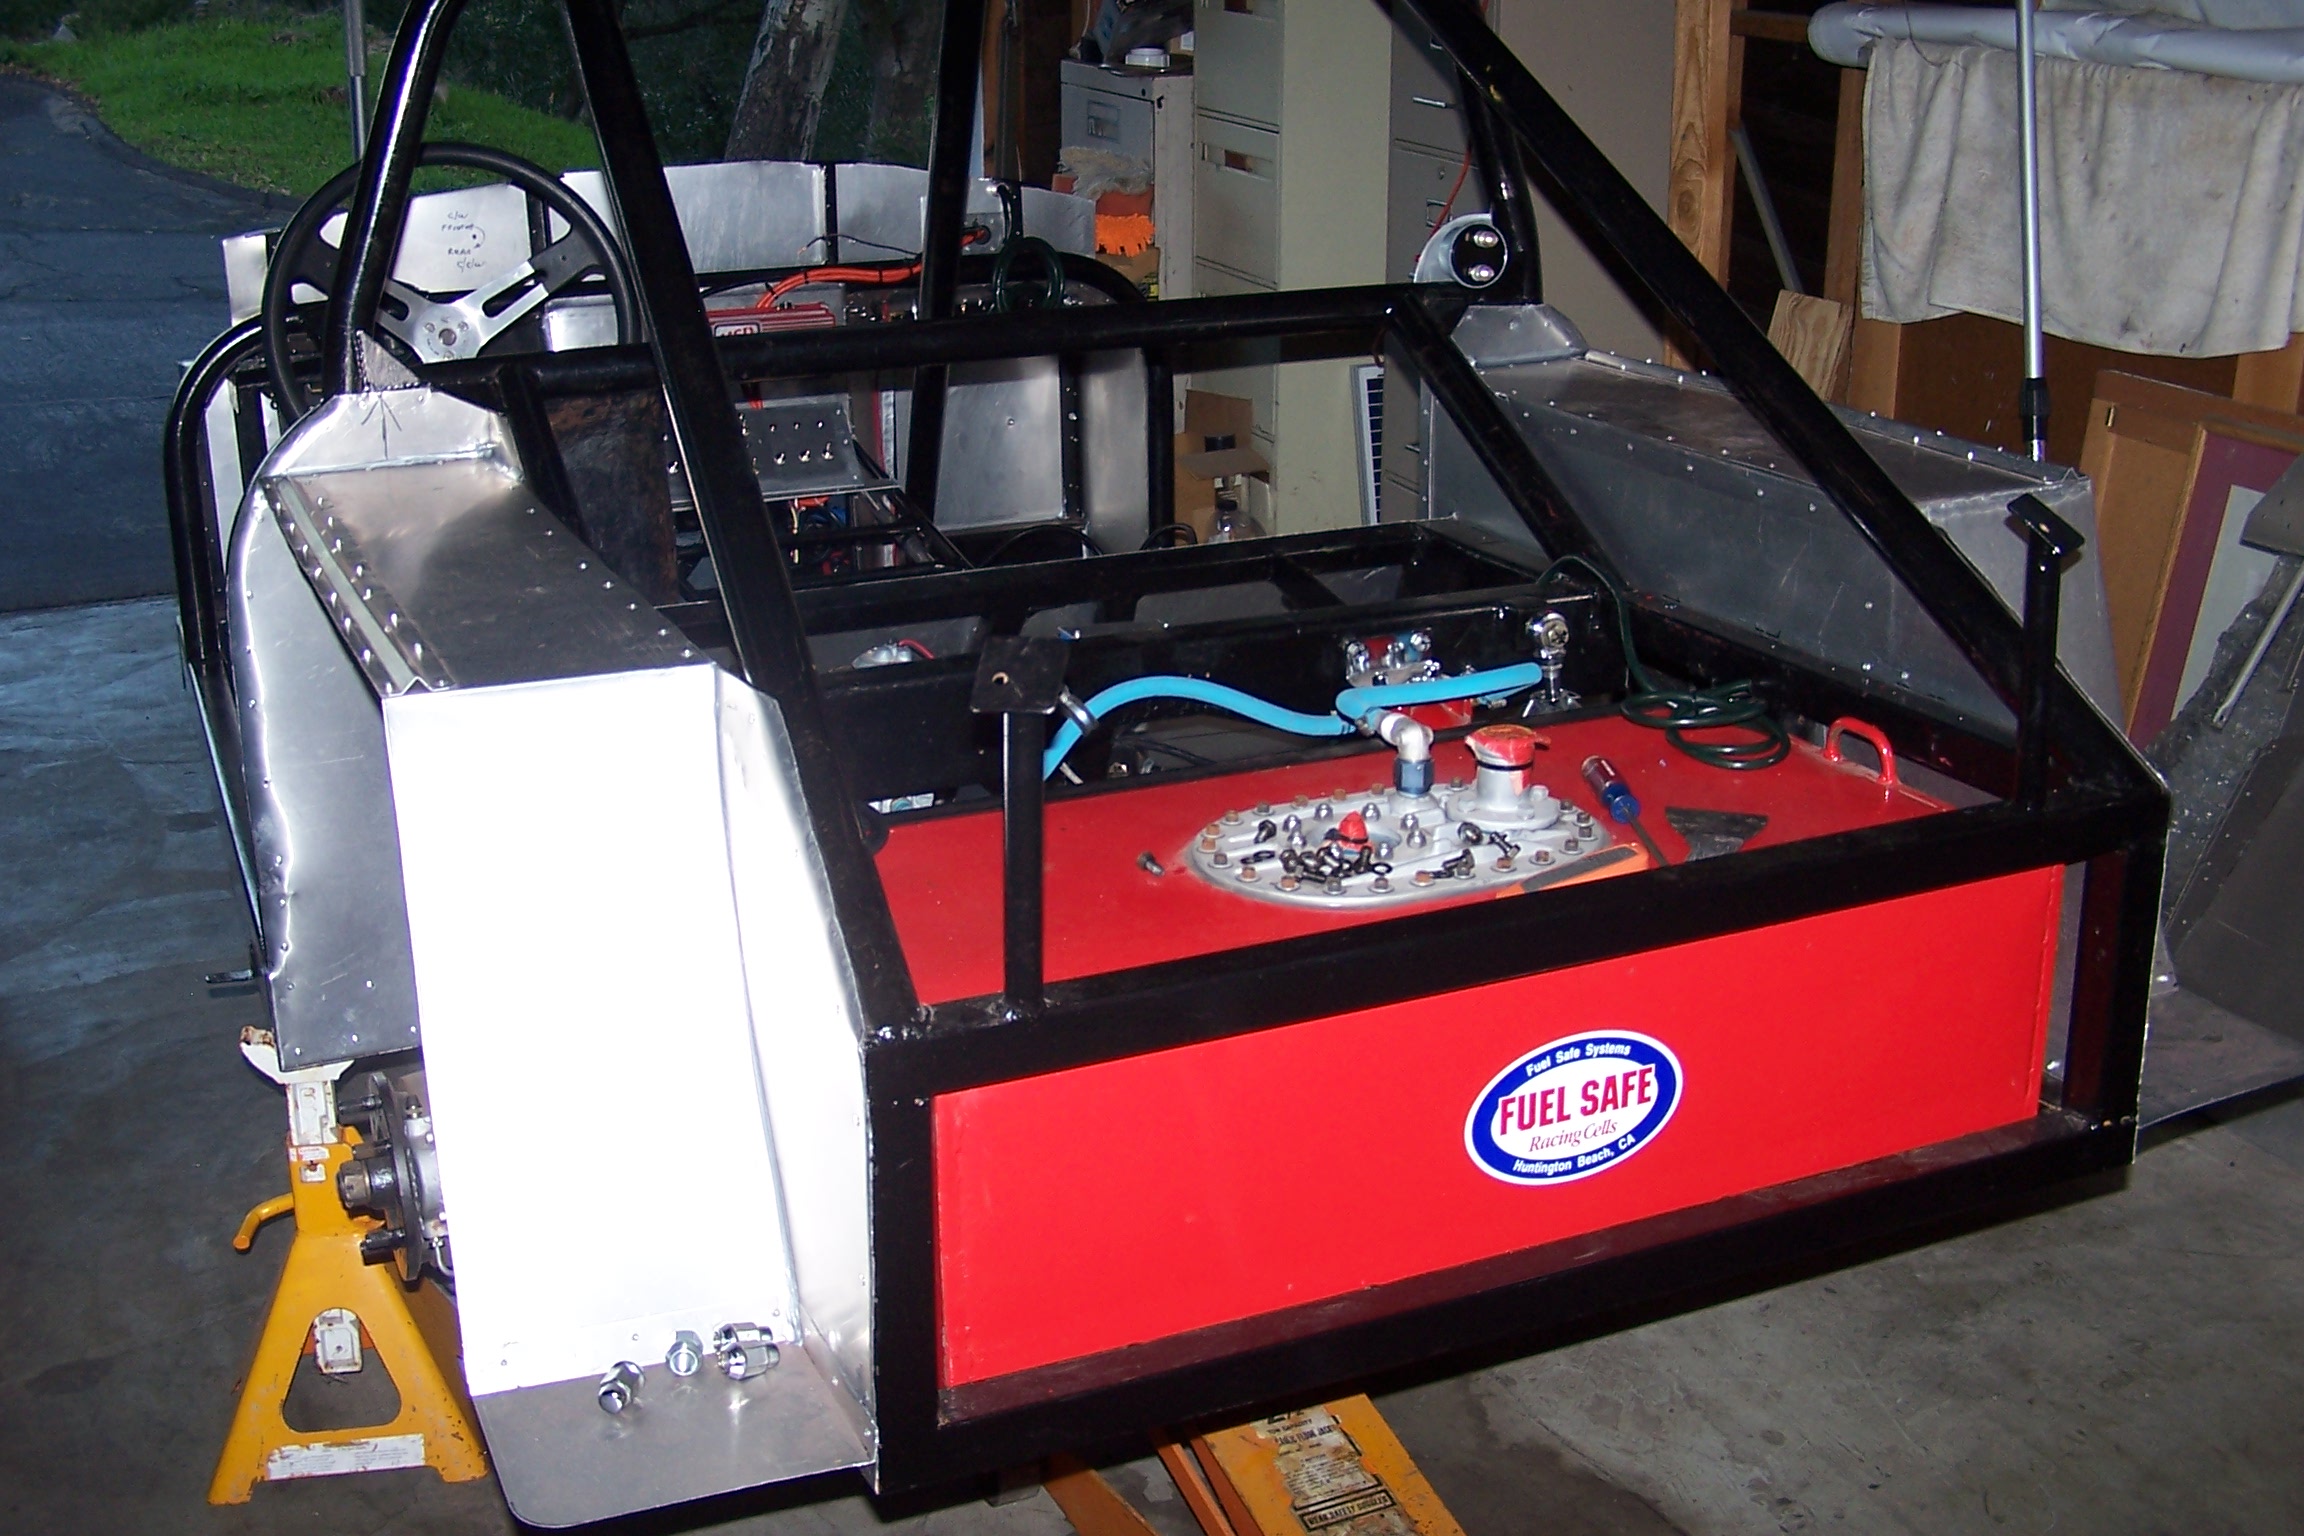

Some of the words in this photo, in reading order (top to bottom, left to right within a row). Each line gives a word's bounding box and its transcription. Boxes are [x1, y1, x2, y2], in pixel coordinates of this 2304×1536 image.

[1526, 1056, 1551, 1077] Fuel
[1555, 1047, 1581, 1064] Safe
[1585, 1042, 1631, 1058] Systems
[1500, 1086, 1571, 1136] FUEL
[1580, 1067, 1653, 1117] SAFE
[1528, 1131, 1581, 1152] Racing
[1583, 1119, 1618, 1140] Cells
[1512, 1159, 1572, 1176] Huntington
[1577, 1147, 1615, 1168] Beach,
[1618, 1134, 1636, 1149] CA
